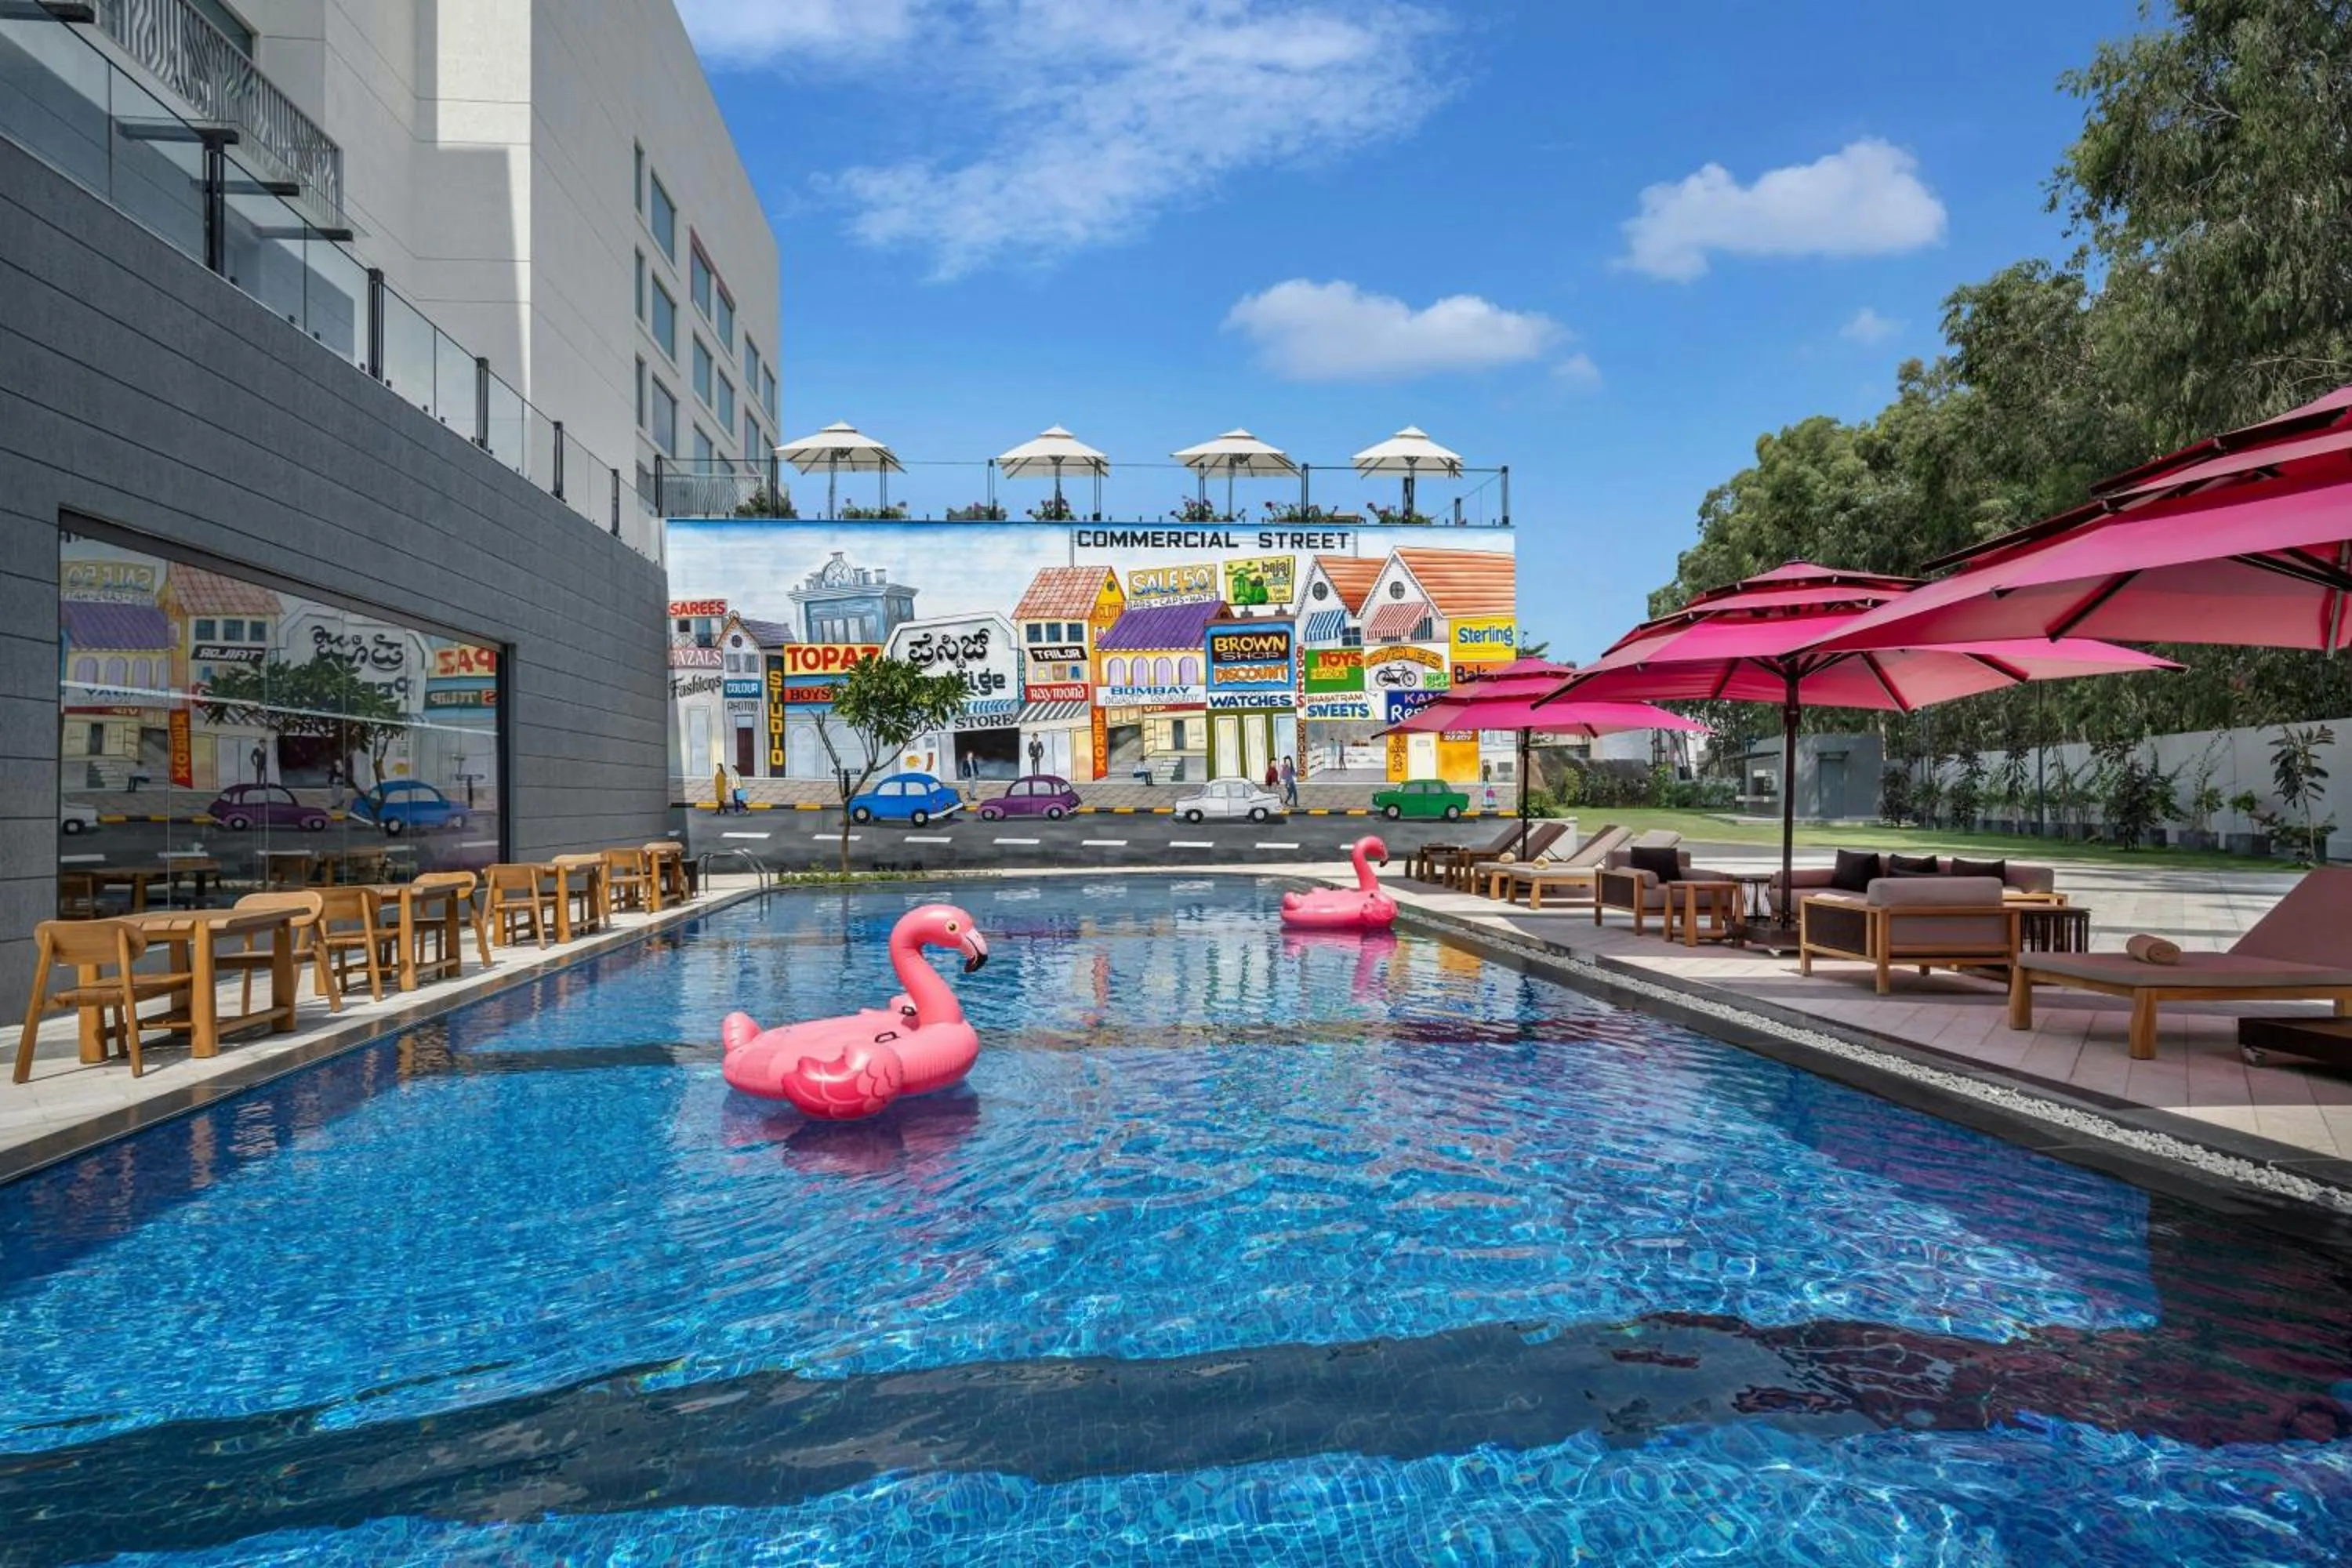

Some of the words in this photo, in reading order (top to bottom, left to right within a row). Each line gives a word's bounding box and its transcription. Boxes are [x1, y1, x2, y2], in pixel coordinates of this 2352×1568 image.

[1076, 531, 1239, 548] COMMERCIAL
[1258, 532, 1351, 549] STREET
[1132, 571, 1178, 595] SALE
[669, 601, 725, 615] SAREES
[1214, 634, 1287, 652] BROWN
[1458, 625, 1515, 647] Sterling
[670, 648, 722, 666] FAZALS
[1033, 648, 1082, 659] TAILOR
[1220, 652, 1279, 661] SHOP
[1319, 652, 1363, 667] TOYS
[1214, 664, 1288, 684] DISCOUNT
[727, 683, 759, 694] COLOUR
[789, 688, 832, 701] BOYS
[1110, 686, 1190, 695] BOMBAY
[727, 700, 759, 713] PHOTOS
[1209, 694, 1293, 708] WATCHES
[768, 670, 783, 766] STUDIO
[1307, 703, 1370, 718] SWEETS
[1390, 704, 1429, 722] Res
[954, 713, 1014, 729] STORE
[1093, 710, 1105, 771] XEROX
